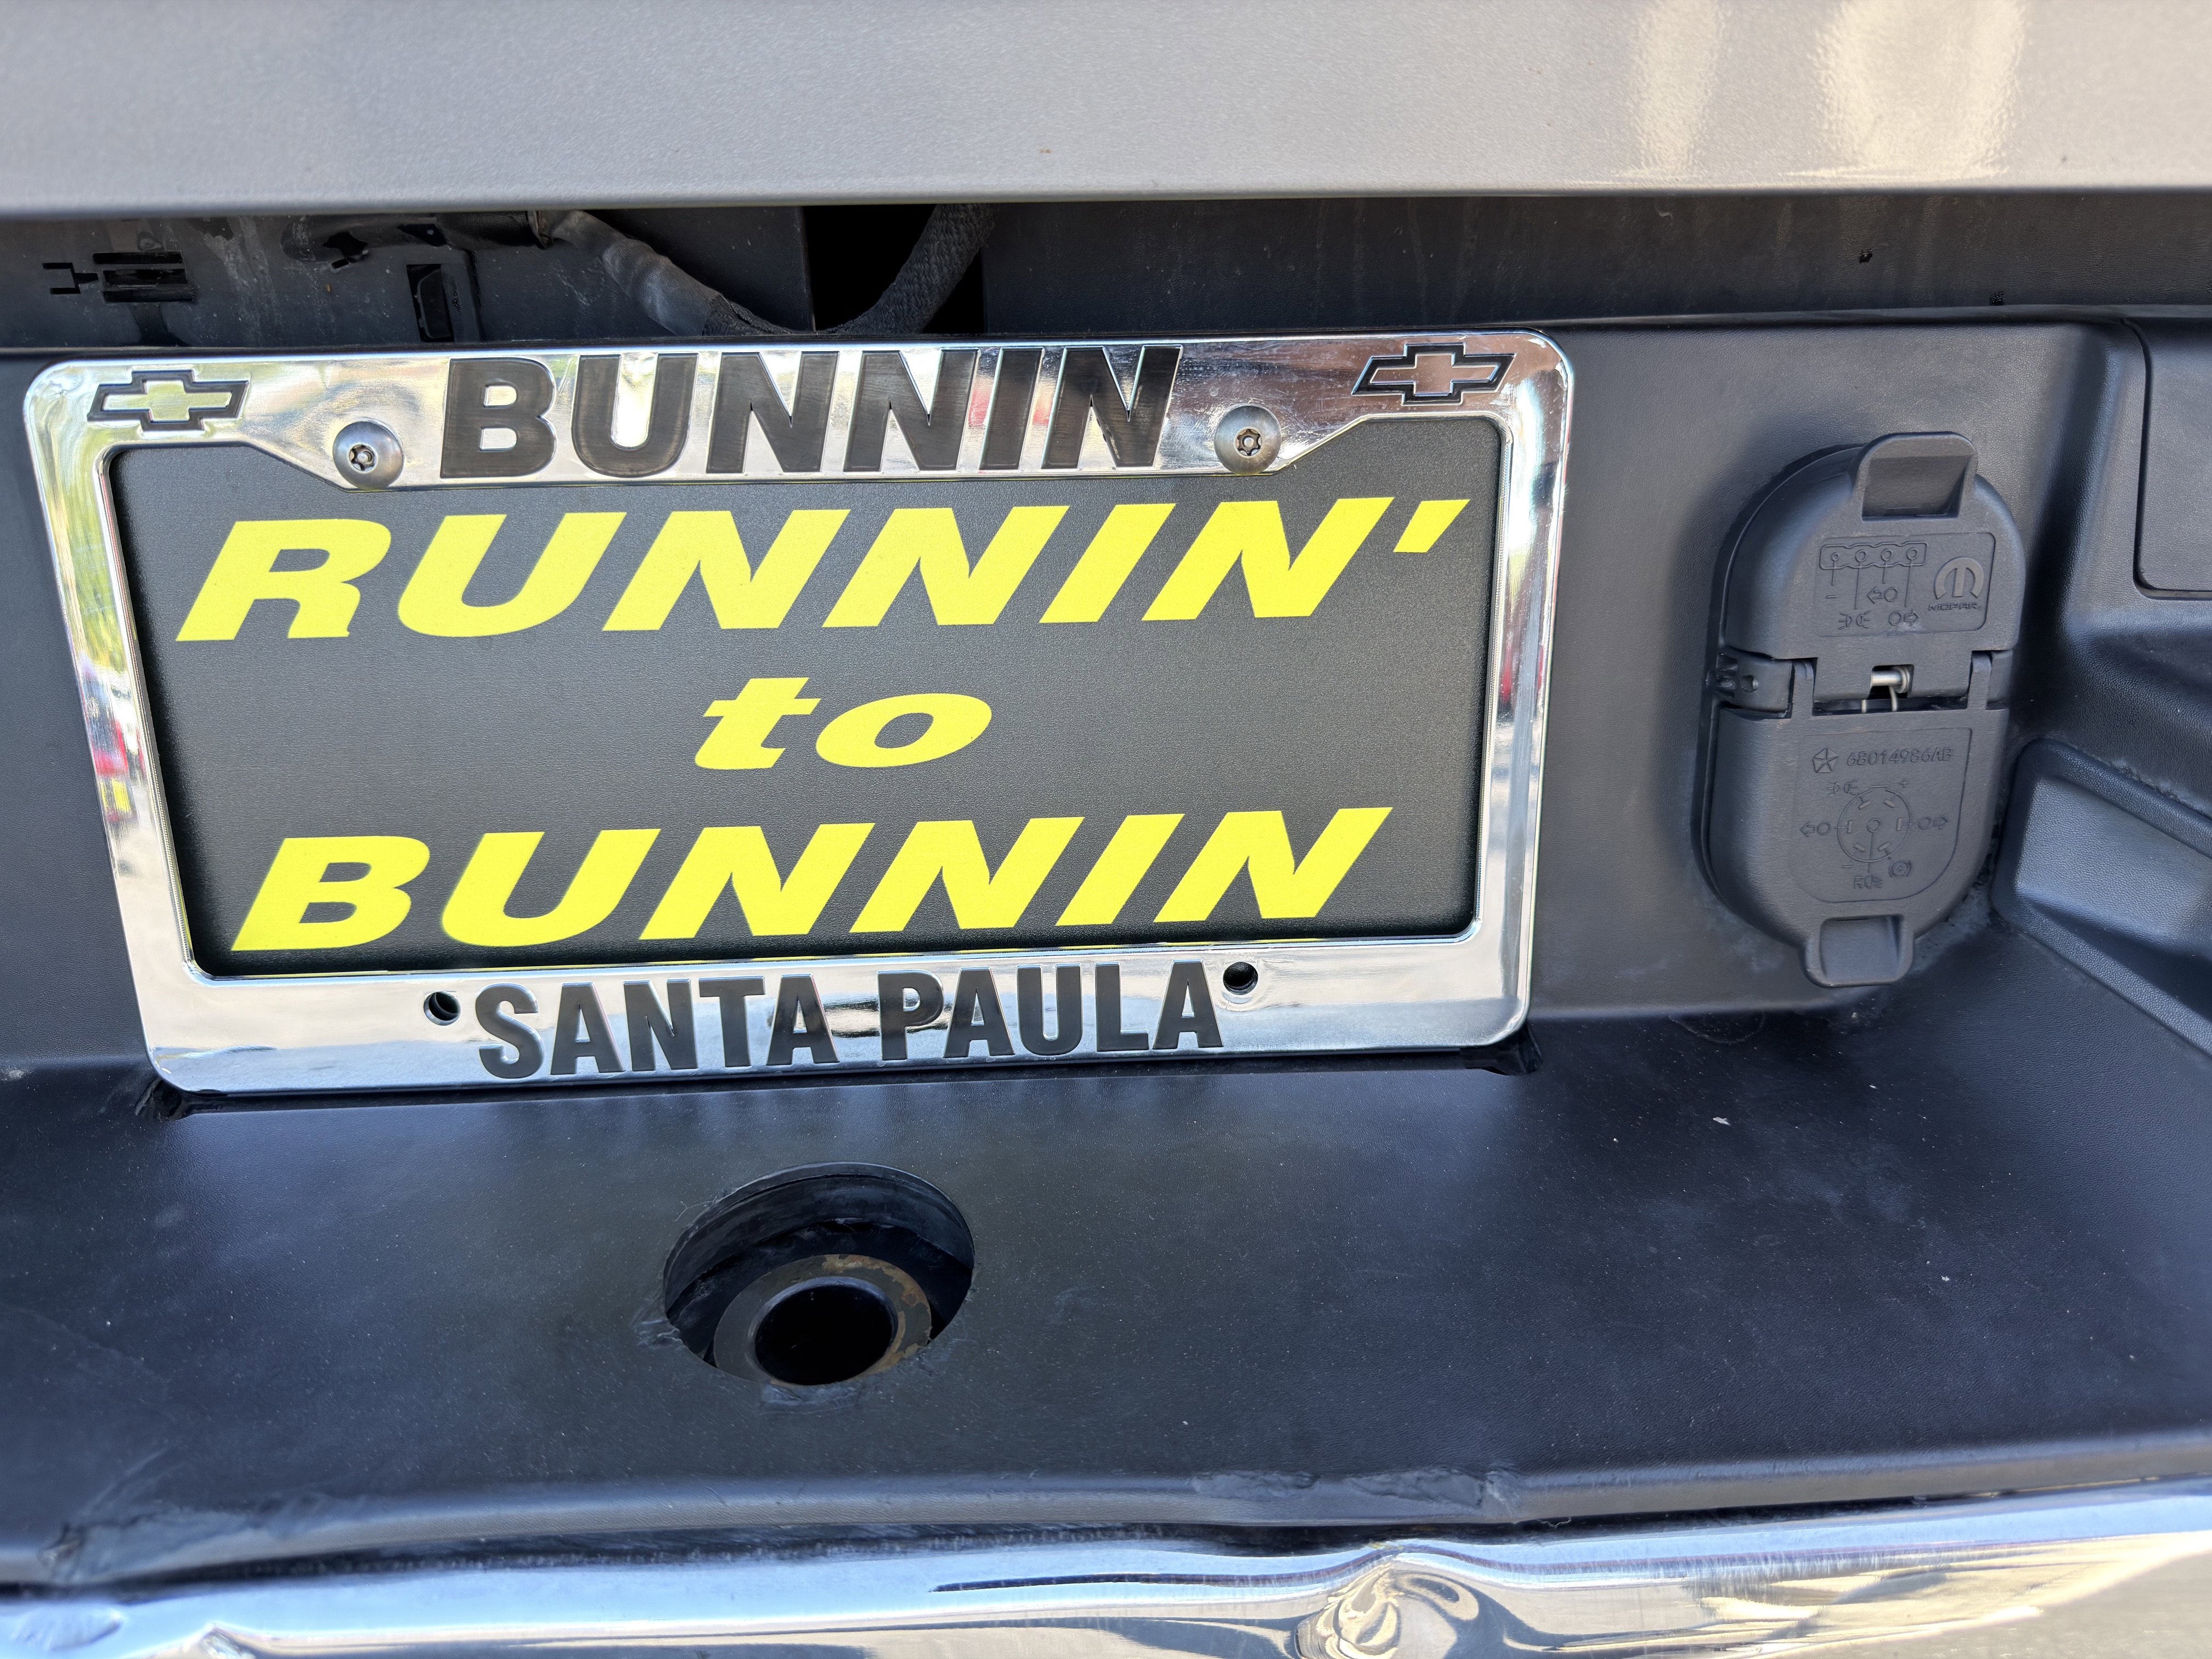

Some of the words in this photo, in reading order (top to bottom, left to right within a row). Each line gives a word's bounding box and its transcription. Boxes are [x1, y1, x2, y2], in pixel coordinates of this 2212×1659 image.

[439, 345, 1182, 478] BUNNIN
[177, 497, 1468, 641] RUNNIN'
[1928, 602, 1977, 611] MOPAR
[696, 678, 991, 769] to
[1847, 747, 1953, 766] 68014986AB
[233, 808, 1391, 951] BUNNIN
[475, 974, 838, 1079] SANTA
[877, 961, 1224, 1062] PAULA
